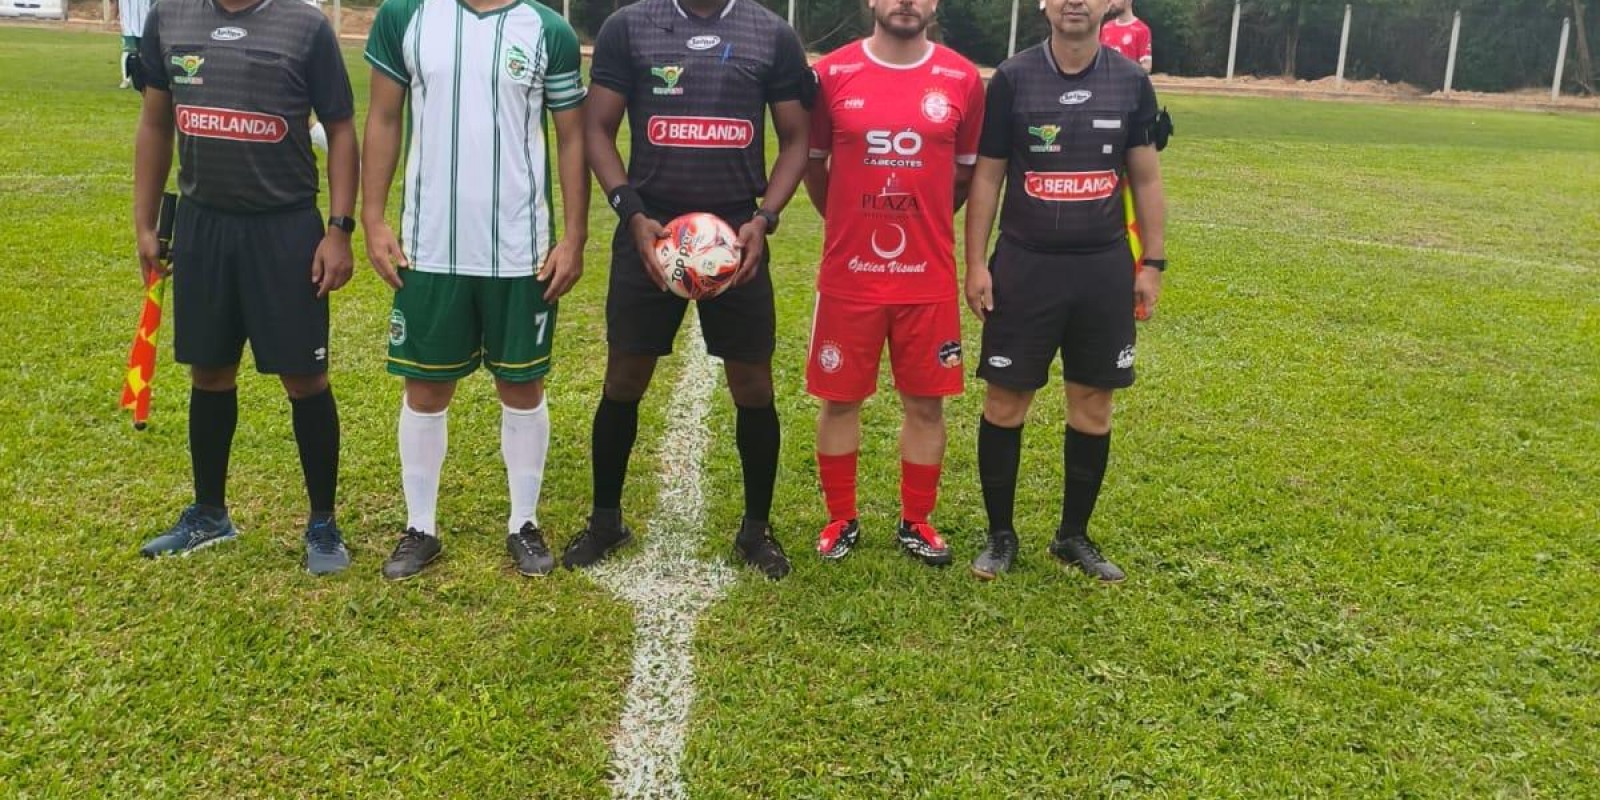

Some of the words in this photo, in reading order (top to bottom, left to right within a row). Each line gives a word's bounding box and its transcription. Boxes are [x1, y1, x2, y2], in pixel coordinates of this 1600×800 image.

[191, 113, 277, 136] BERLANDA
[669, 123, 746, 141] BERLANDA
[866, 128, 922, 156] SÓ
[863, 194, 919, 211] PLAZA
[887, 260, 927, 274] Visual
[535, 311, 549, 345] 7
